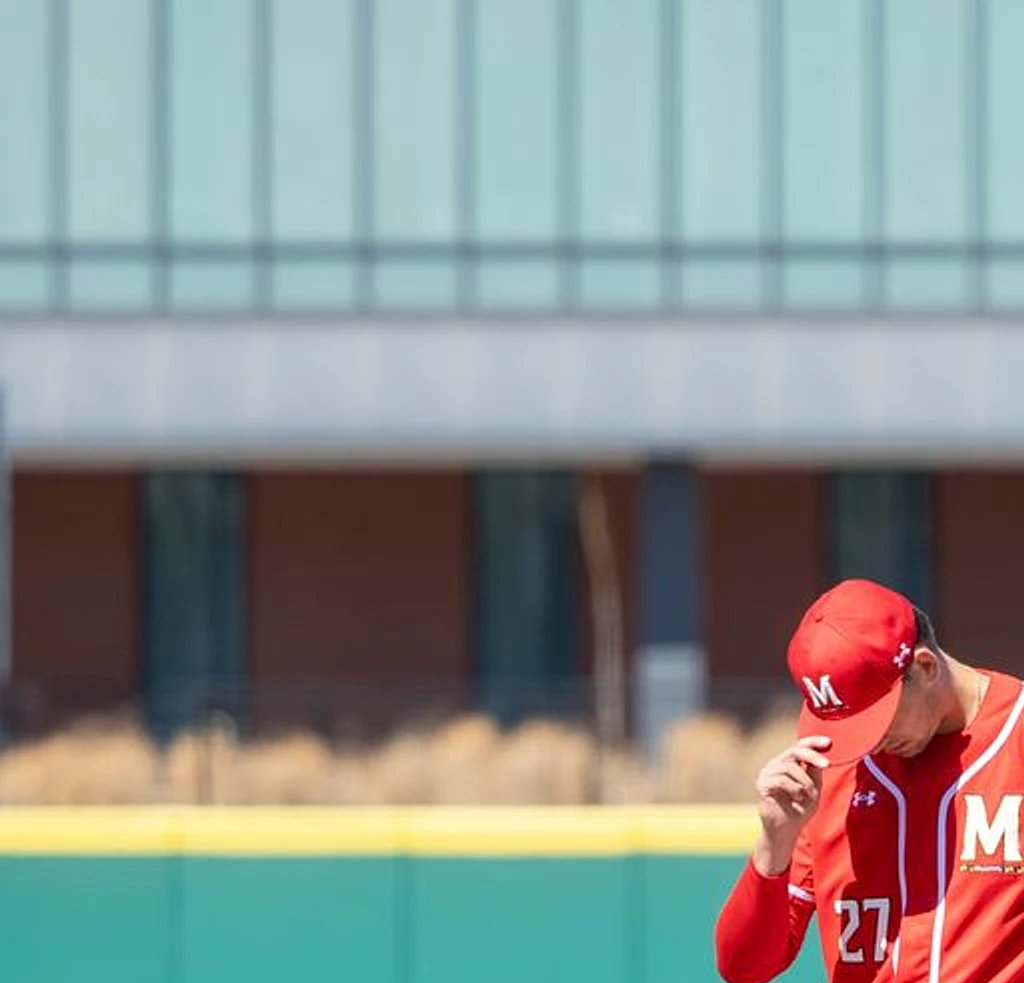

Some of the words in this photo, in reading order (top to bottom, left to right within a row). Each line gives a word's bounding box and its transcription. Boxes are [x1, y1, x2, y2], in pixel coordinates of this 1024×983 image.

[802, 674, 844, 708] M
[960, 793, 1024, 862] M
[834, 897, 890, 963] 27
